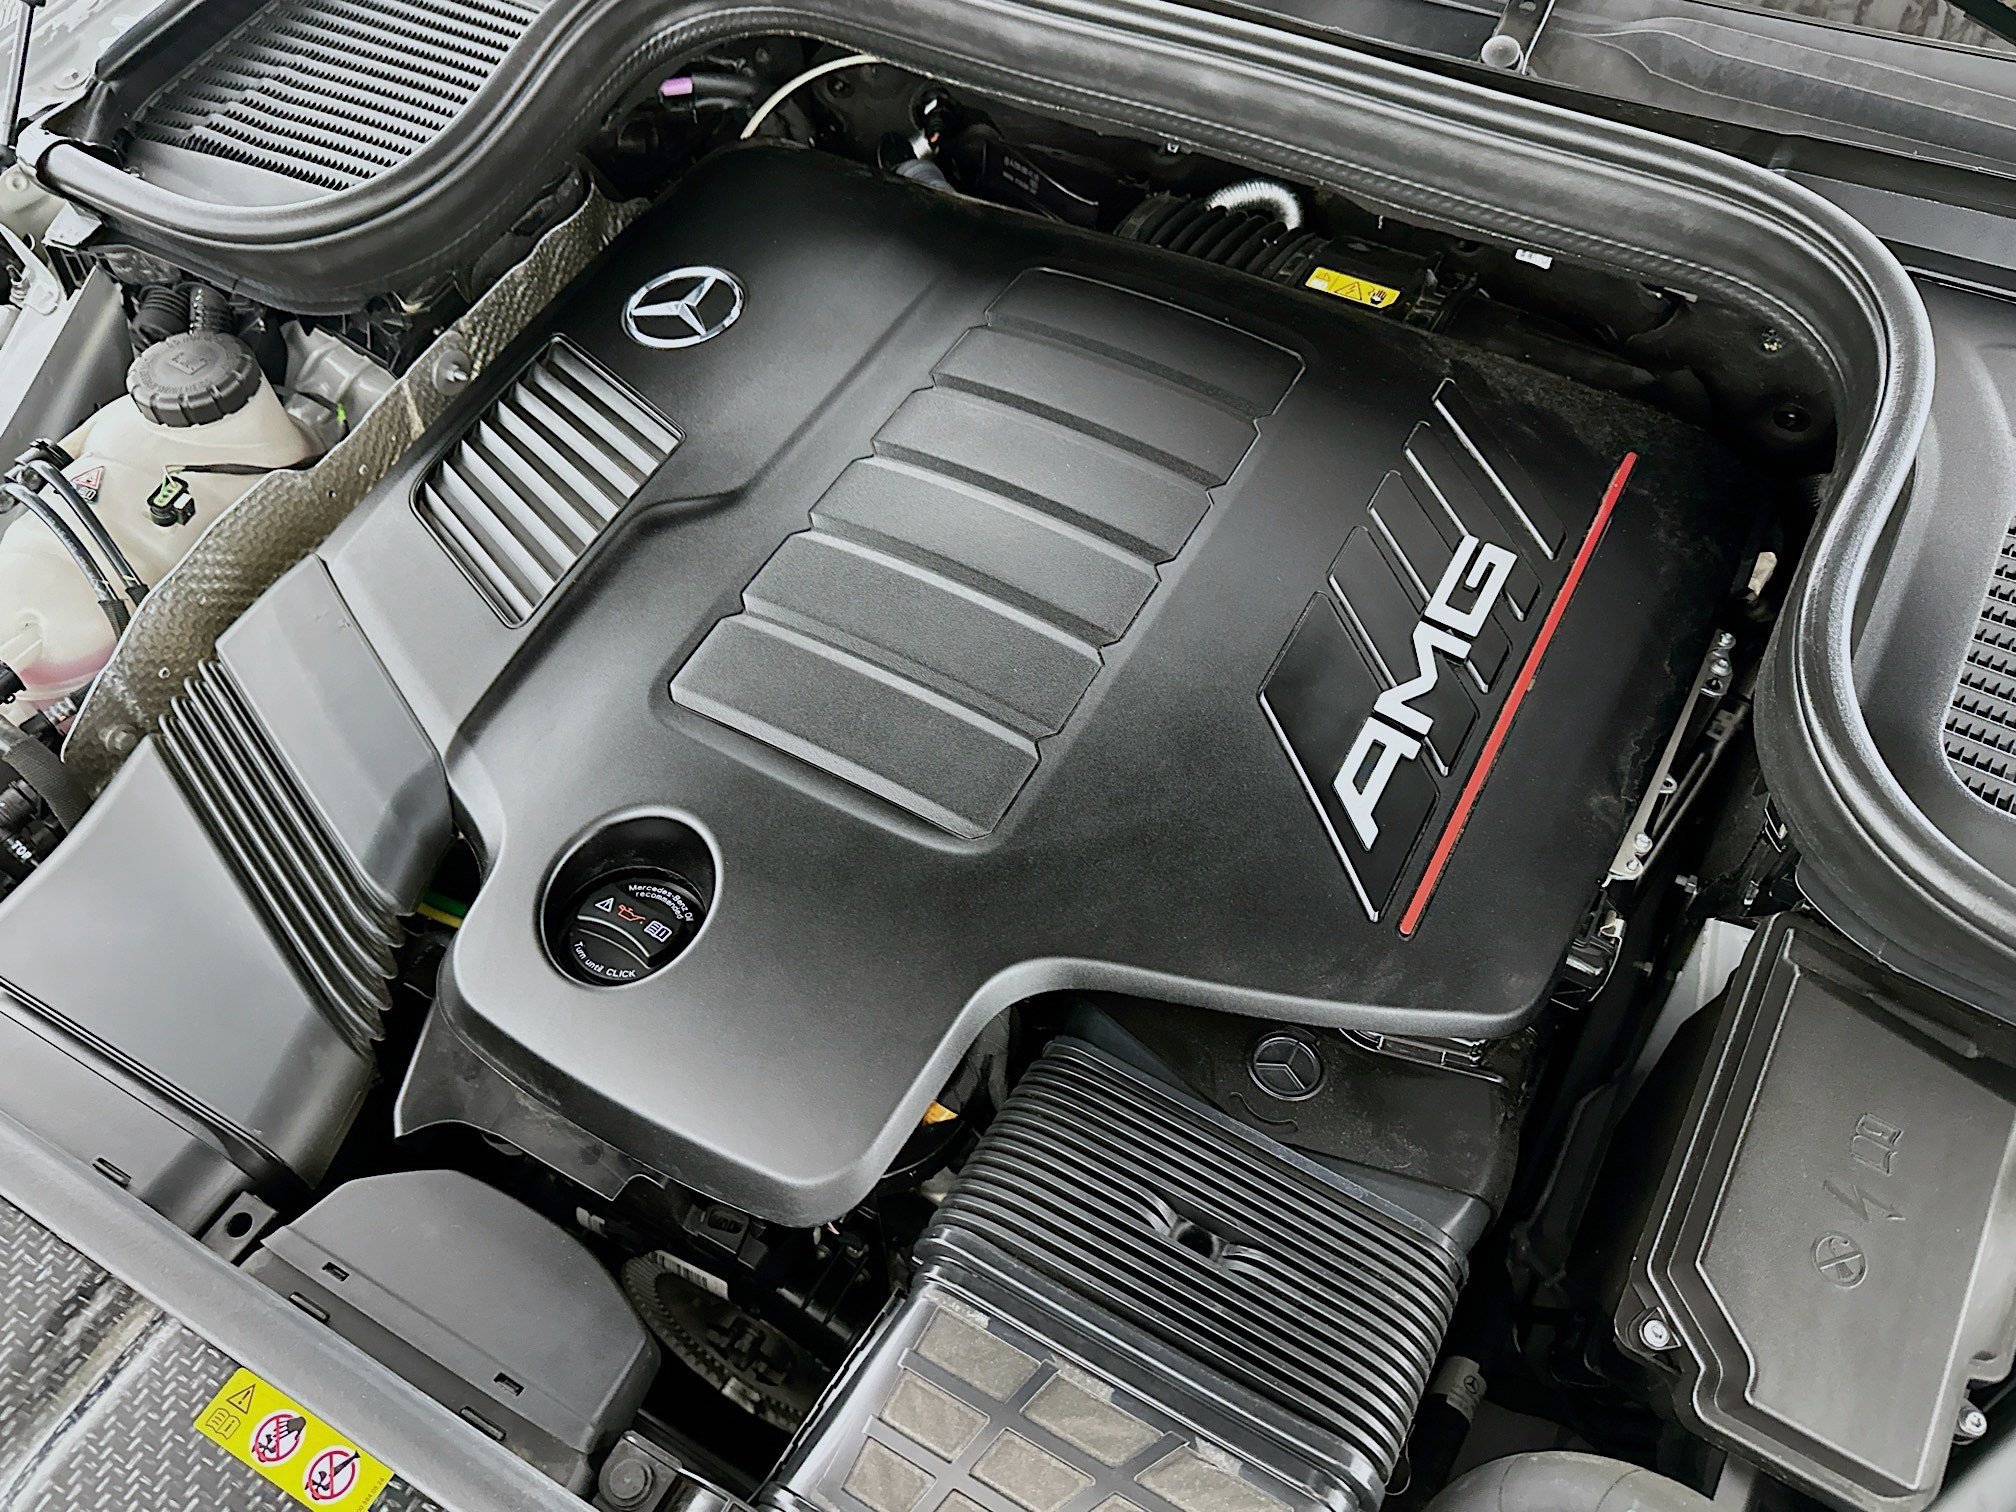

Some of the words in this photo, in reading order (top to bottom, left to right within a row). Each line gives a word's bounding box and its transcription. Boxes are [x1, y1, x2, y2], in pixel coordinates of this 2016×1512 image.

[1332, 535, 1518, 851] AMG
[628, 884, 689, 912] Mercedes-Benz
[684, 912, 694, 922] Oil
[635, 891, 684, 920] recommended
[574, 941, 587, 960] Turn
[585, 959, 605, 973] until
[605, 968, 636, 978] CLICK
